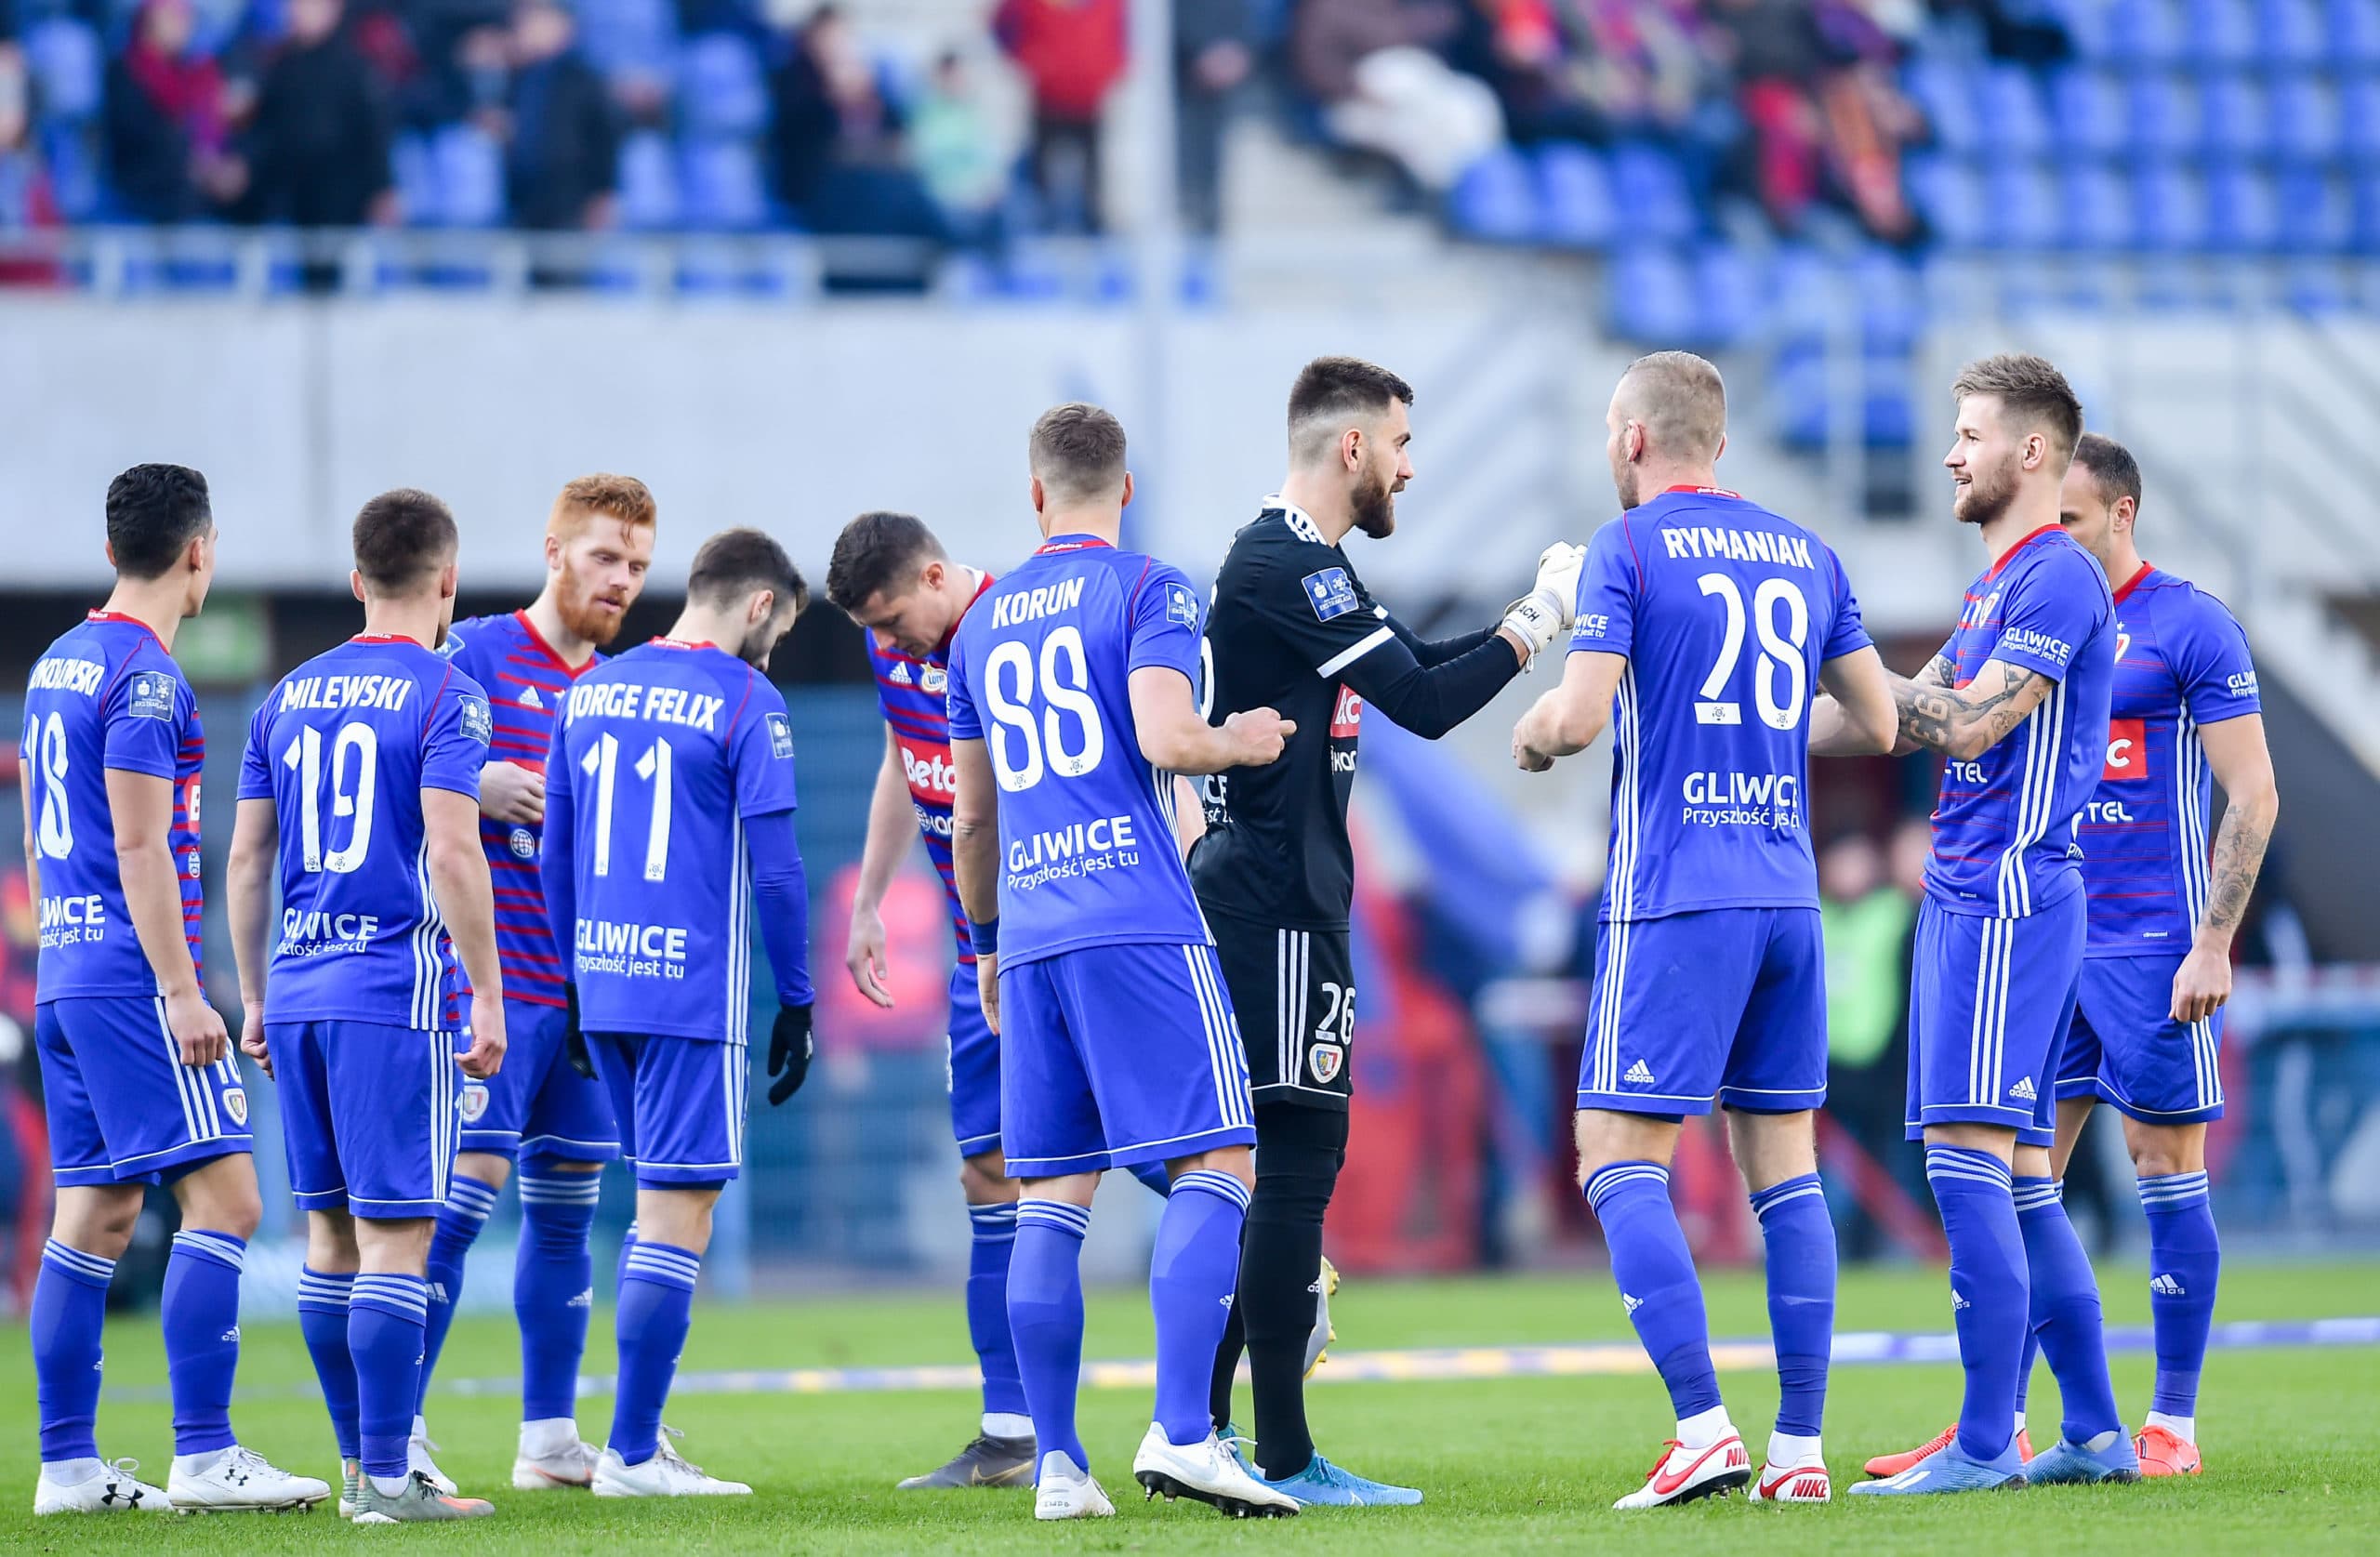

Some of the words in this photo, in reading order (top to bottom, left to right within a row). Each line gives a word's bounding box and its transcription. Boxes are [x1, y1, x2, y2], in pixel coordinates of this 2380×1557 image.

[1660, 527, 1815, 570] RYMANIAK
[991, 577, 1086, 629] KORUN
[1693, 573, 1808, 731] 28
[2005, 627, 2071, 659] GLIWICE
[279, 675, 413, 713] MILEWSKI
[565, 683, 642, 729] JORGE
[642, 686, 724, 732] FELIX
[984, 626, 1104, 792] 88
[283, 721, 377, 874] 19
[581, 731, 672, 884] 11
[1682, 804, 1770, 828] Przyszłość
[1008, 815, 1137, 872] GLIWICE
[1007, 856, 1080, 891] Przyszłość
[1078, 851, 1117, 877] jest
[1117, 850, 1140, 866] tu
[59, 925, 81, 948] jest
[84, 926, 104, 942] tu
[575, 917, 688, 960] GLIWICE
[626, 957, 662, 979] jest
[665, 960, 685, 980] tu
[1315, 982, 1356, 1046] 26
[1623, 1073, 1656, 1084] adidas
[1791, 1479, 1828, 1498] NIKE
